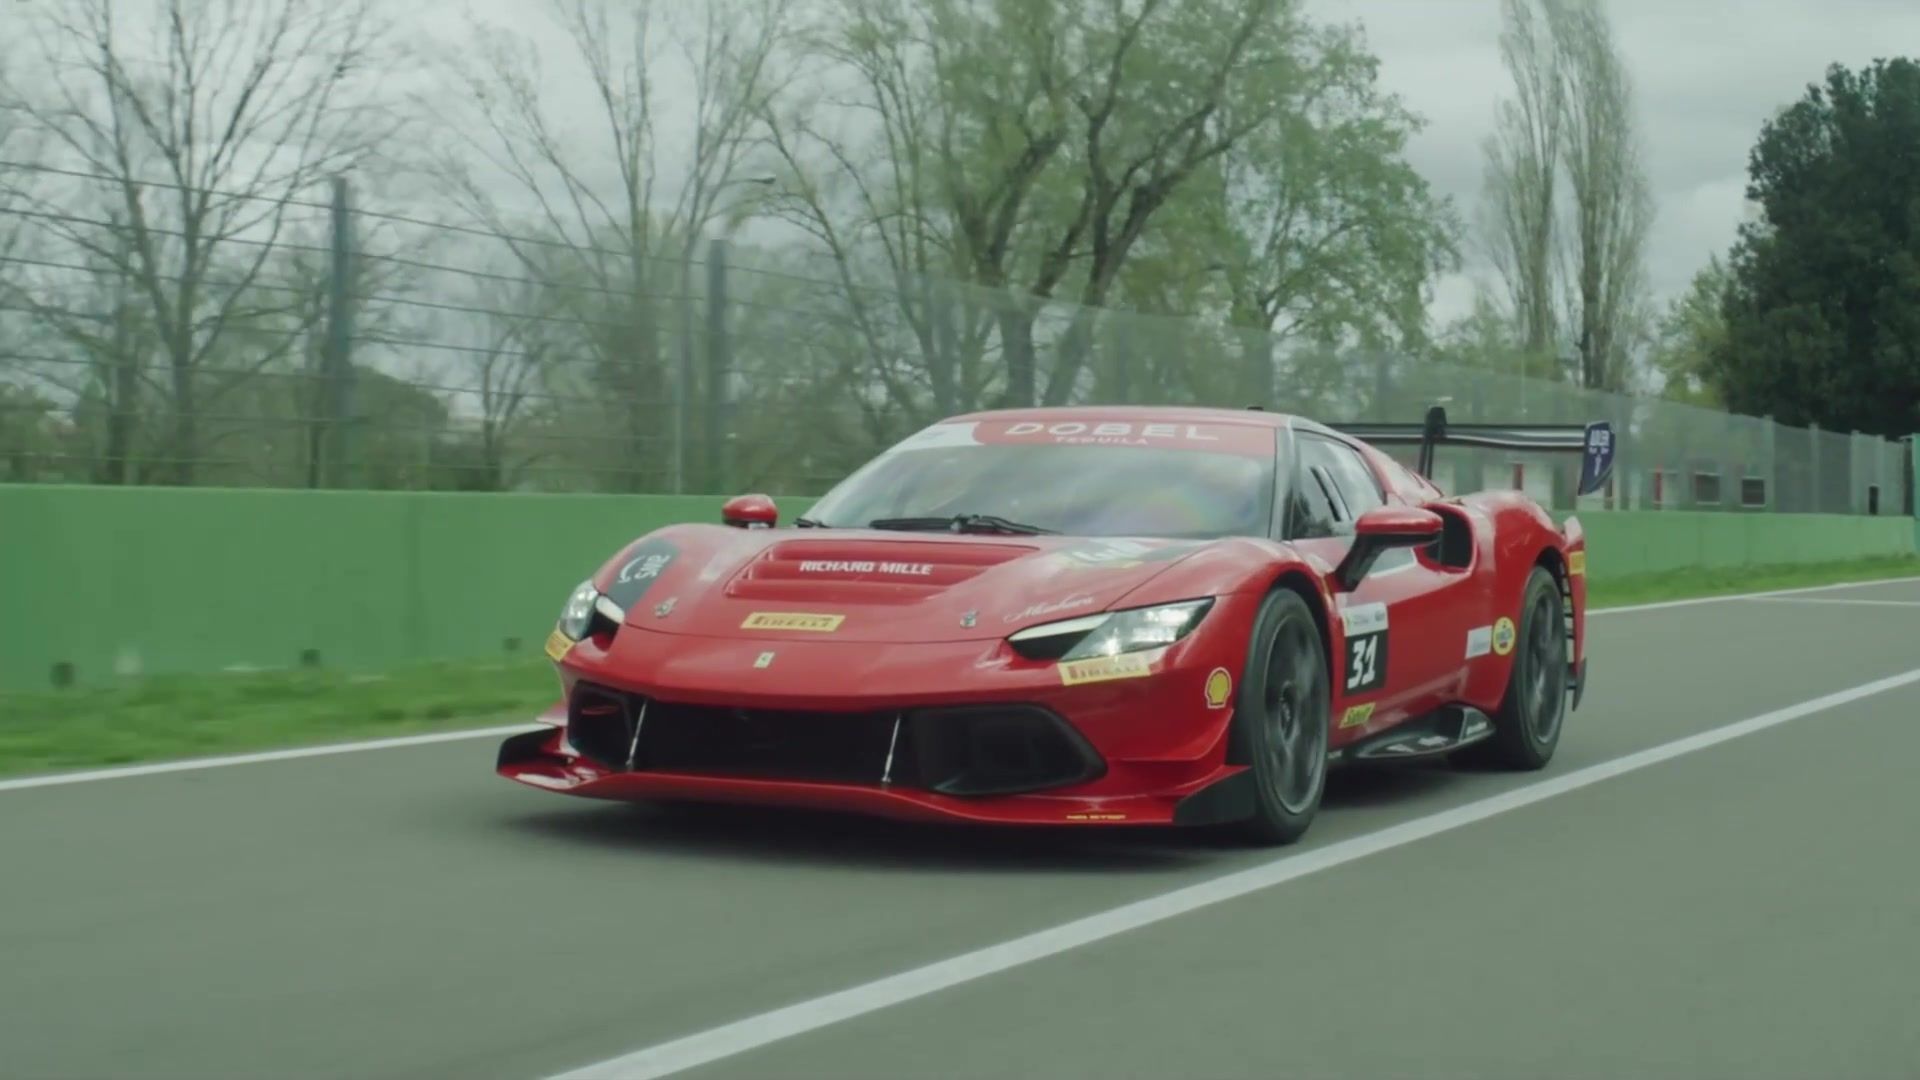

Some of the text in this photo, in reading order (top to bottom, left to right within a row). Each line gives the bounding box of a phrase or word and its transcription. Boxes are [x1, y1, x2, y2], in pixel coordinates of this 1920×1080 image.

[1005, 423, 1219, 441] DOBEL
[1055, 437, 1149, 446] TEQUILA
[799, 560, 934, 576] RICHARD MILLE
[752, 614, 834, 629] PIRELLI
[1347, 635, 1378, 689] 31
